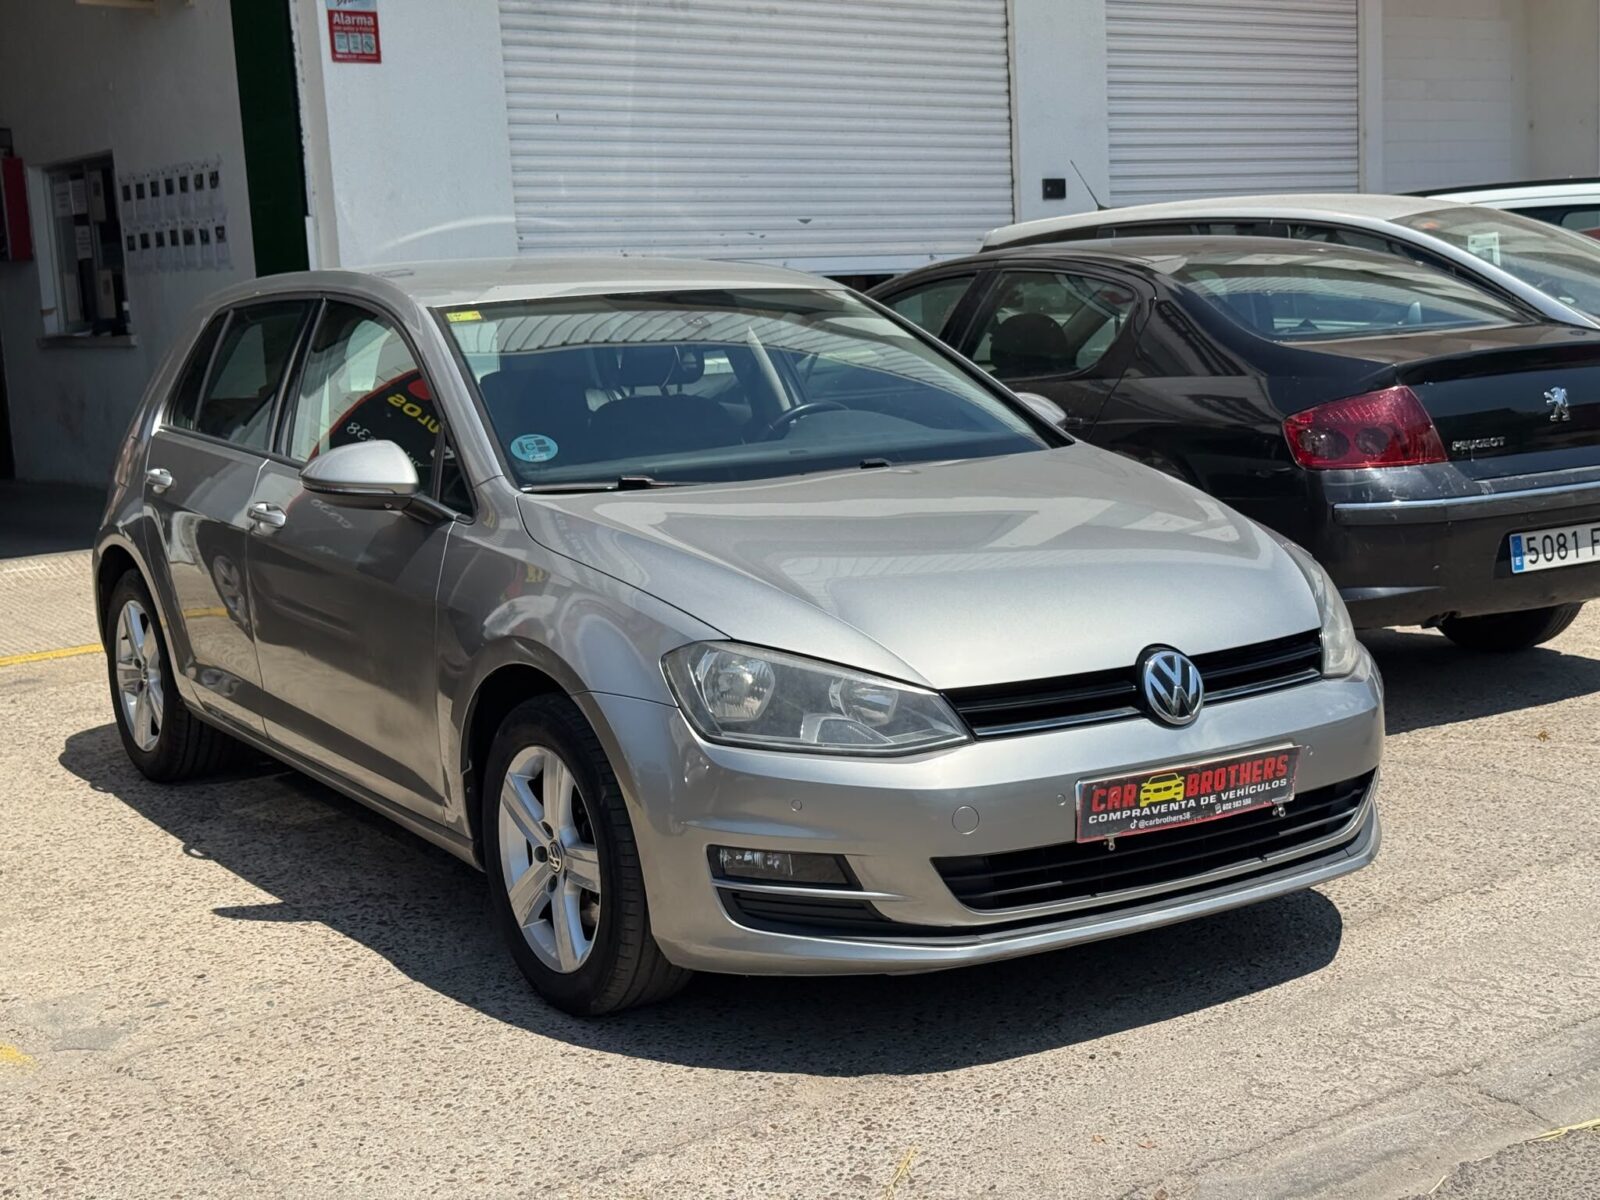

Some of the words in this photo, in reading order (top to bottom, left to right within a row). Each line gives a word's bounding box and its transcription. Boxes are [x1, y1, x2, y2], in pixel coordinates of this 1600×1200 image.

[333, 12, 375, 26] Alarma
[1452, 436, 1505, 451] PEUGEOT
[1526, 530, 1579, 564] 5081
[1092, 784, 1137, 812] CAR
[1186, 754, 1289, 797] BROTHERS
[1088, 799, 1196, 824] COMPRAVENTA
[1200, 794, 1217, 806] DE
[1221, 778, 1288, 801] VEHÍCULOS
